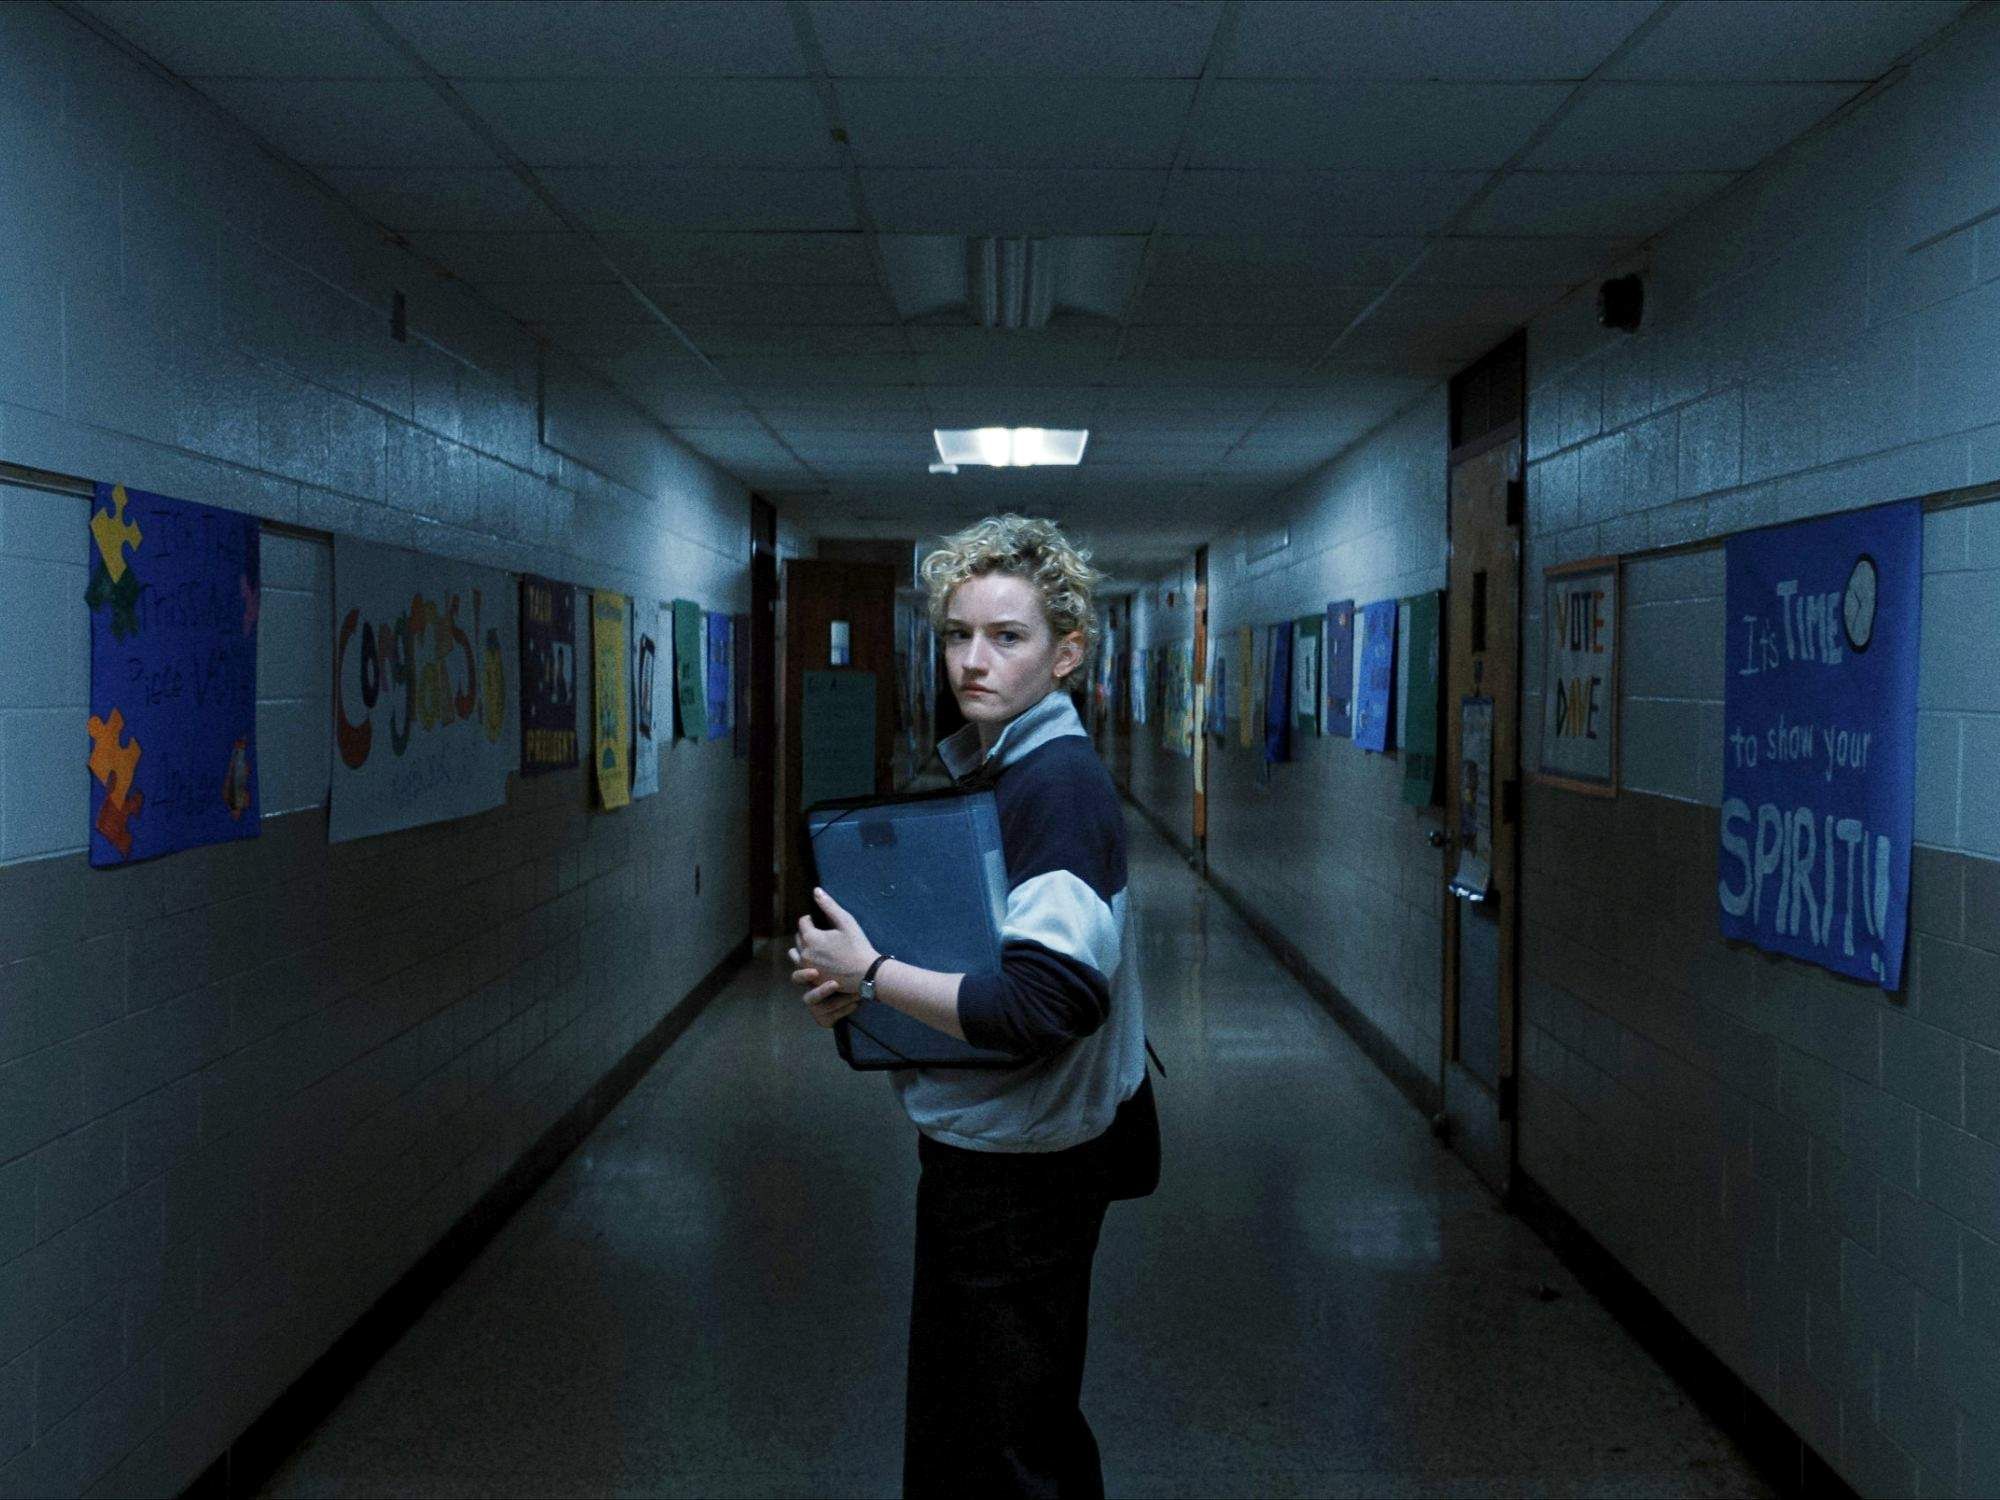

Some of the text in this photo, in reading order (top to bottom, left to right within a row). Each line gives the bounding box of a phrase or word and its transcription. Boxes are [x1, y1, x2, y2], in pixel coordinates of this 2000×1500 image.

[1555, 590, 1605, 653] VOTE
[1776, 579, 1844, 666] TIME
[1555, 676, 1602, 739] DAVE
[1729, 714, 1872, 783] to show your
